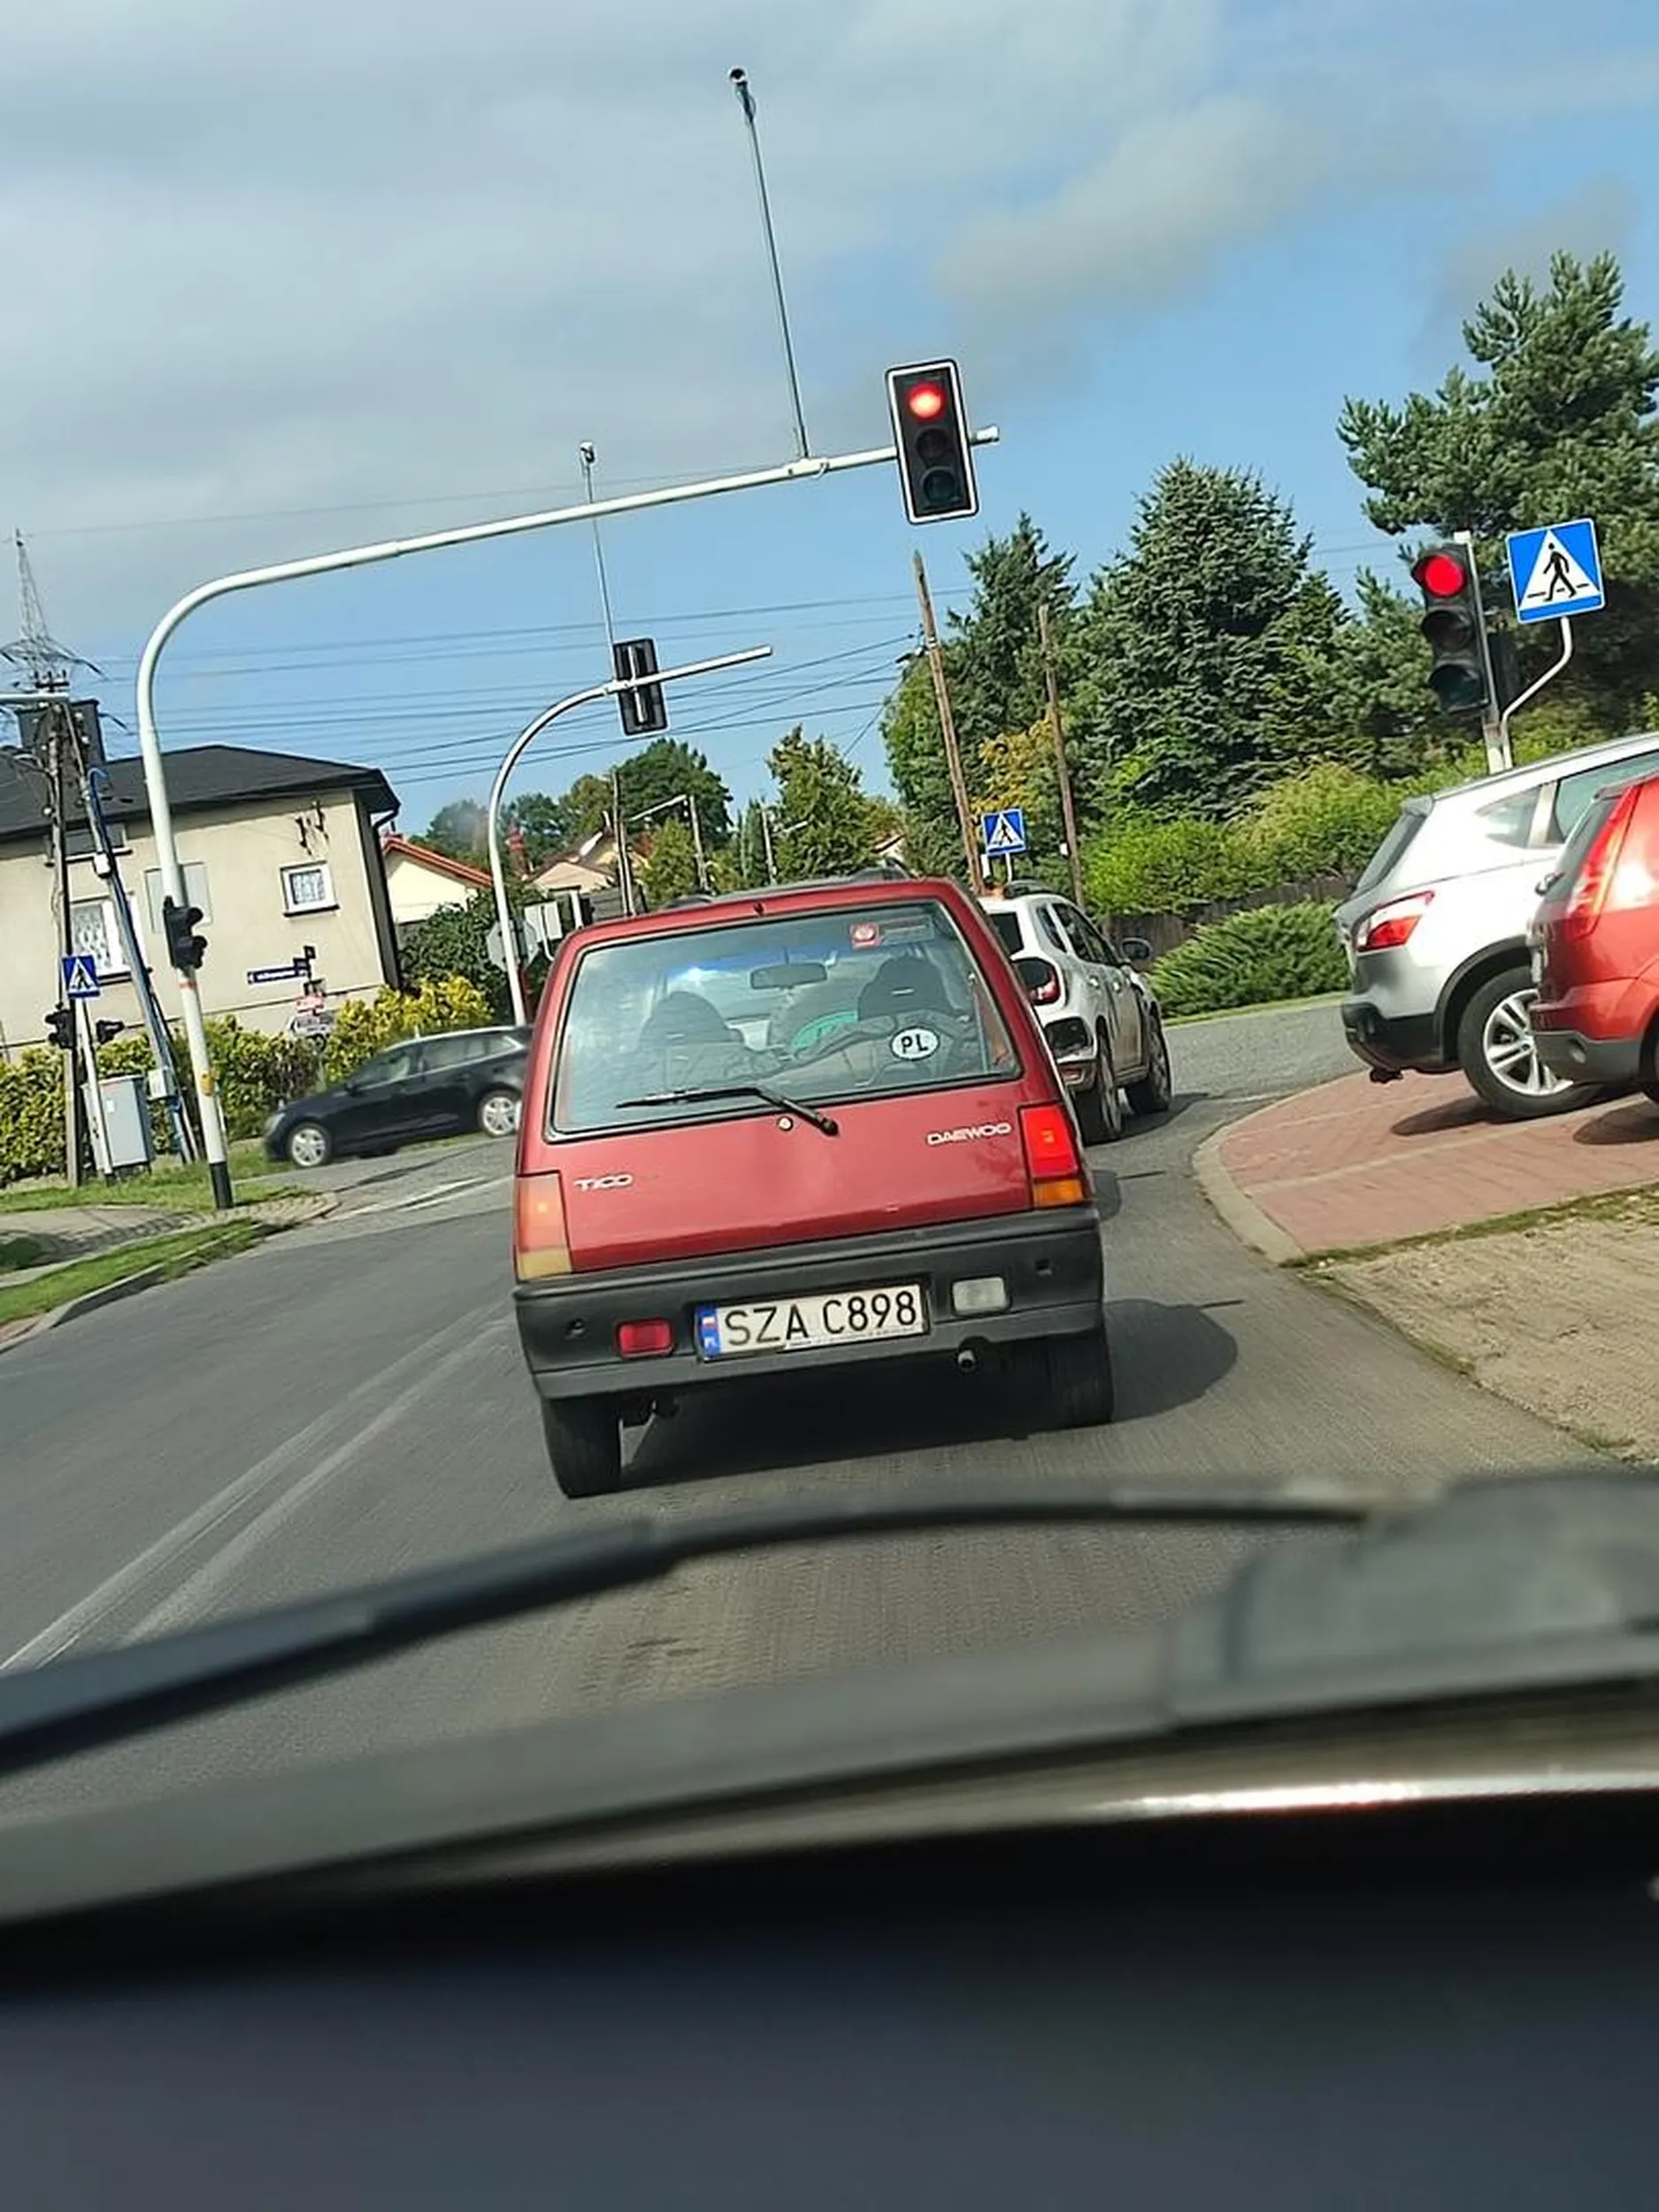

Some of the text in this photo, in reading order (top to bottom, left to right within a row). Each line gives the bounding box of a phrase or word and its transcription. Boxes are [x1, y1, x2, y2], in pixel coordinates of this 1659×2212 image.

[901, 1034, 928, 1053] PL
[926, 1122, 1012, 1146] DAEWOO
[572, 1174, 634, 1192] TICO
[724, 1305, 809, 1347] SZA
[823, 1290, 918, 1334] C898
